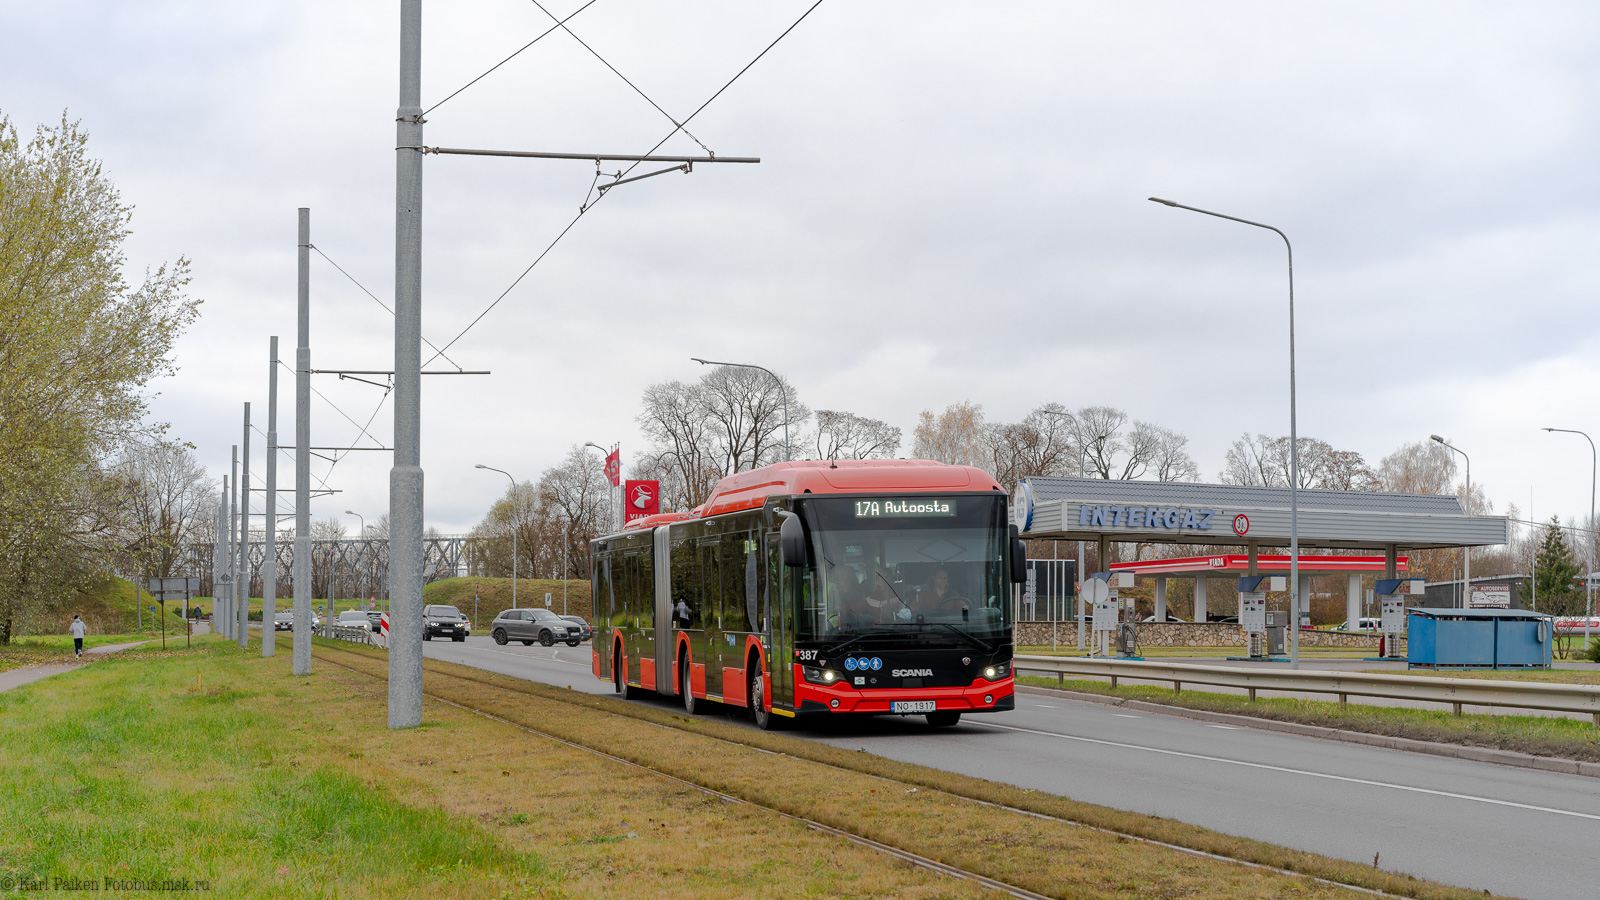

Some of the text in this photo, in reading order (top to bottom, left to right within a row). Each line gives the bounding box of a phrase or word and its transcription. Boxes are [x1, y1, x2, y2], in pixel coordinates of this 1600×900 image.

[856, 500, 950, 516] 17A Autoosta
[1079, 505, 1216, 530] INTERGAZ
[1209, 557, 1225, 567] VIADA
[800, 650, 818, 661] 387
[891, 668, 934, 677] SCANIA
